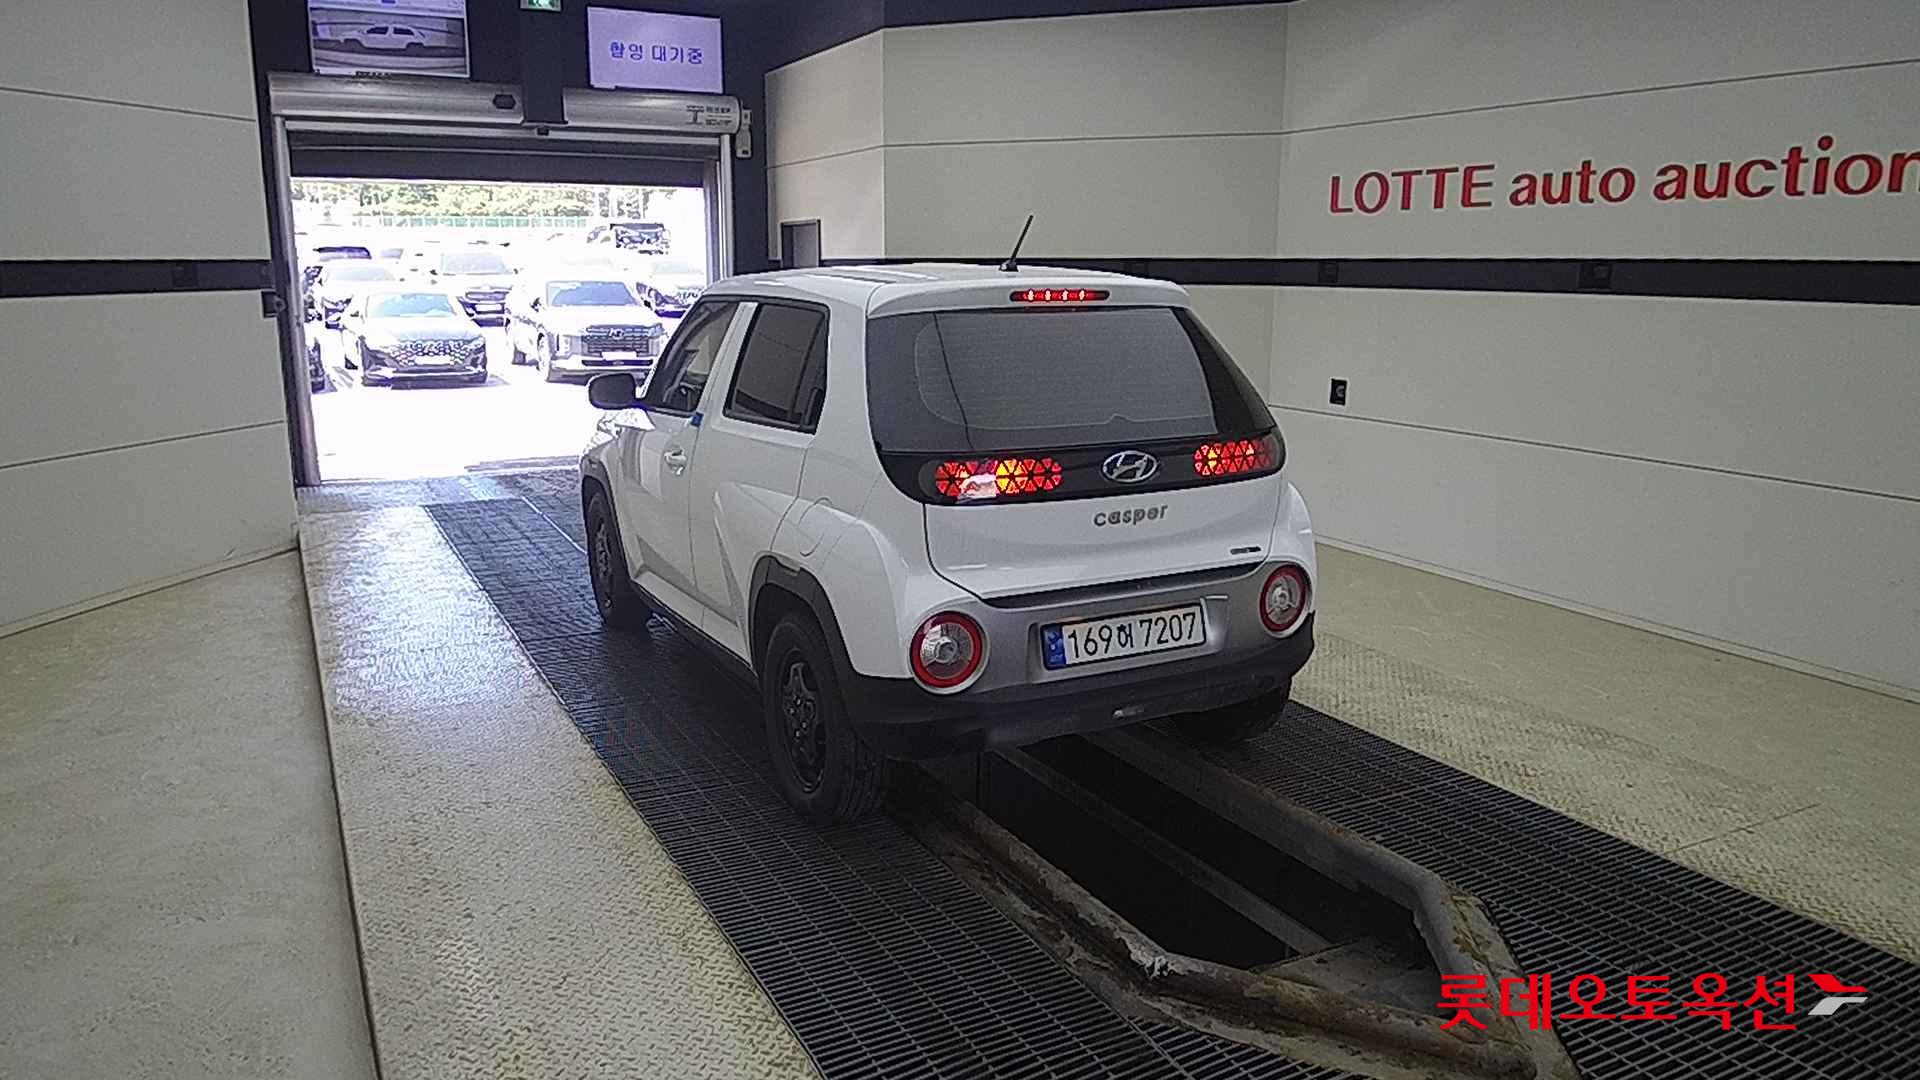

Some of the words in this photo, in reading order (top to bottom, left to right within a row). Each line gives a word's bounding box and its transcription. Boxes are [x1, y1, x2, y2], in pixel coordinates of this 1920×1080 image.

[652, 44, 703, 65] 대기중
[1330, 164, 1495, 213] LOTTE
[1509, 160, 1636, 206] auto
[1094, 504, 1168, 527] casper
[1068, 622, 1134, 658] 169허
[1139, 612, 1196, 647] 7207
